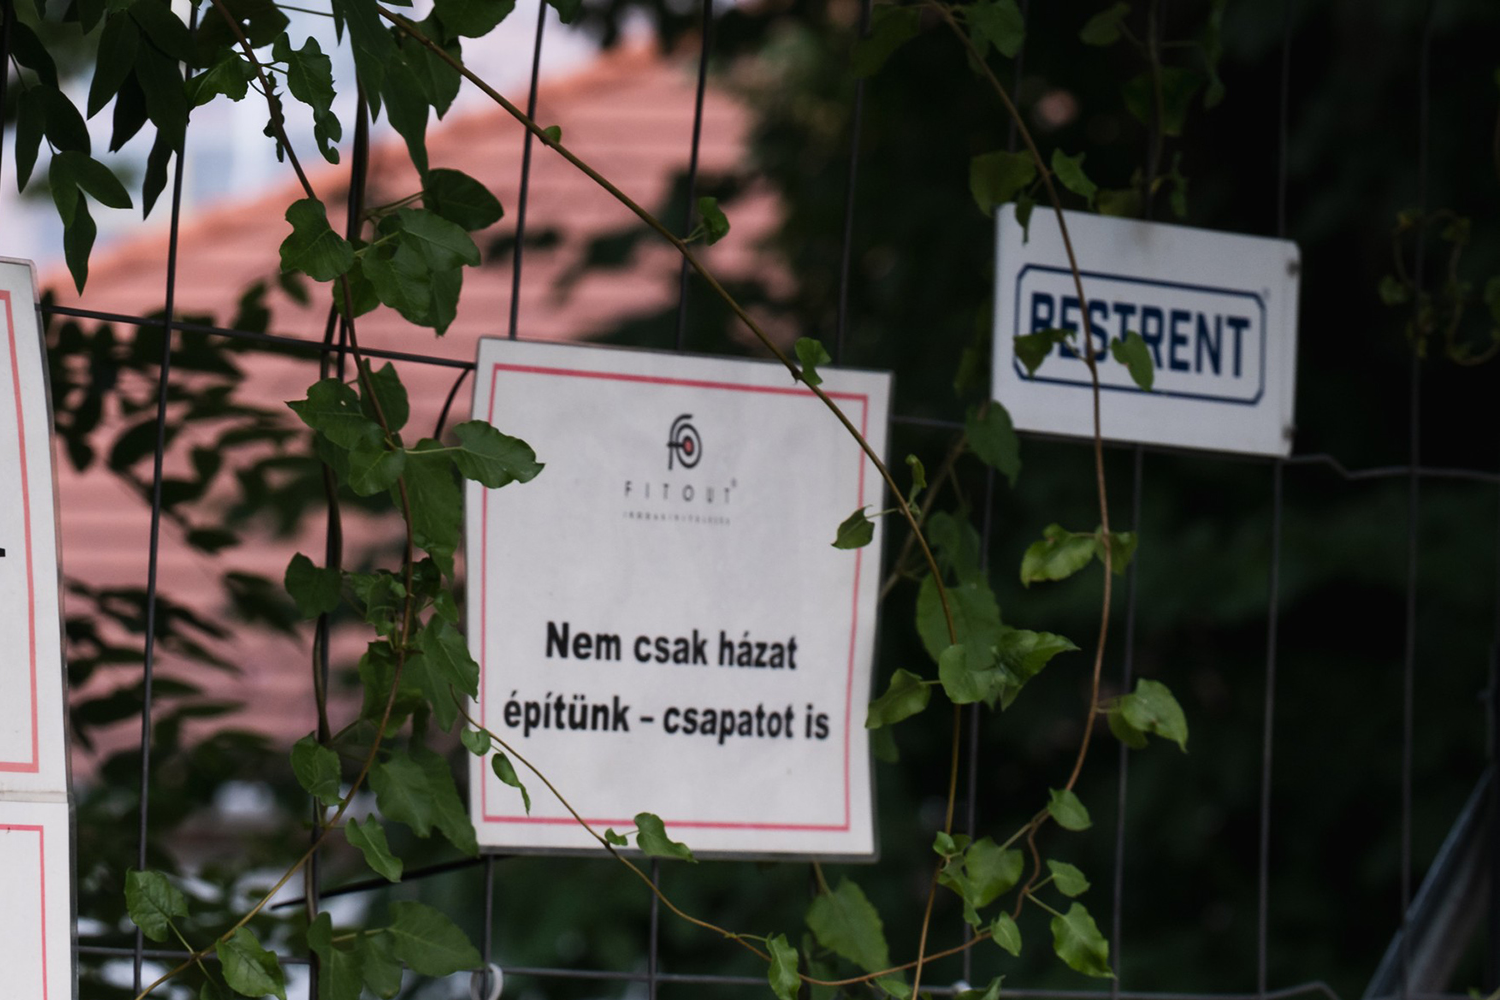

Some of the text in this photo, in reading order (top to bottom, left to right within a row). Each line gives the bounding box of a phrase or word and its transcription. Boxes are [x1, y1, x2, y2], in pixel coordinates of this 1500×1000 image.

[545, 621, 798, 670] Nem csak házat
[503, 690, 630, 738] építünk
[663, 703, 795, 746] csapatot
[805, 703, 830, 741] is
